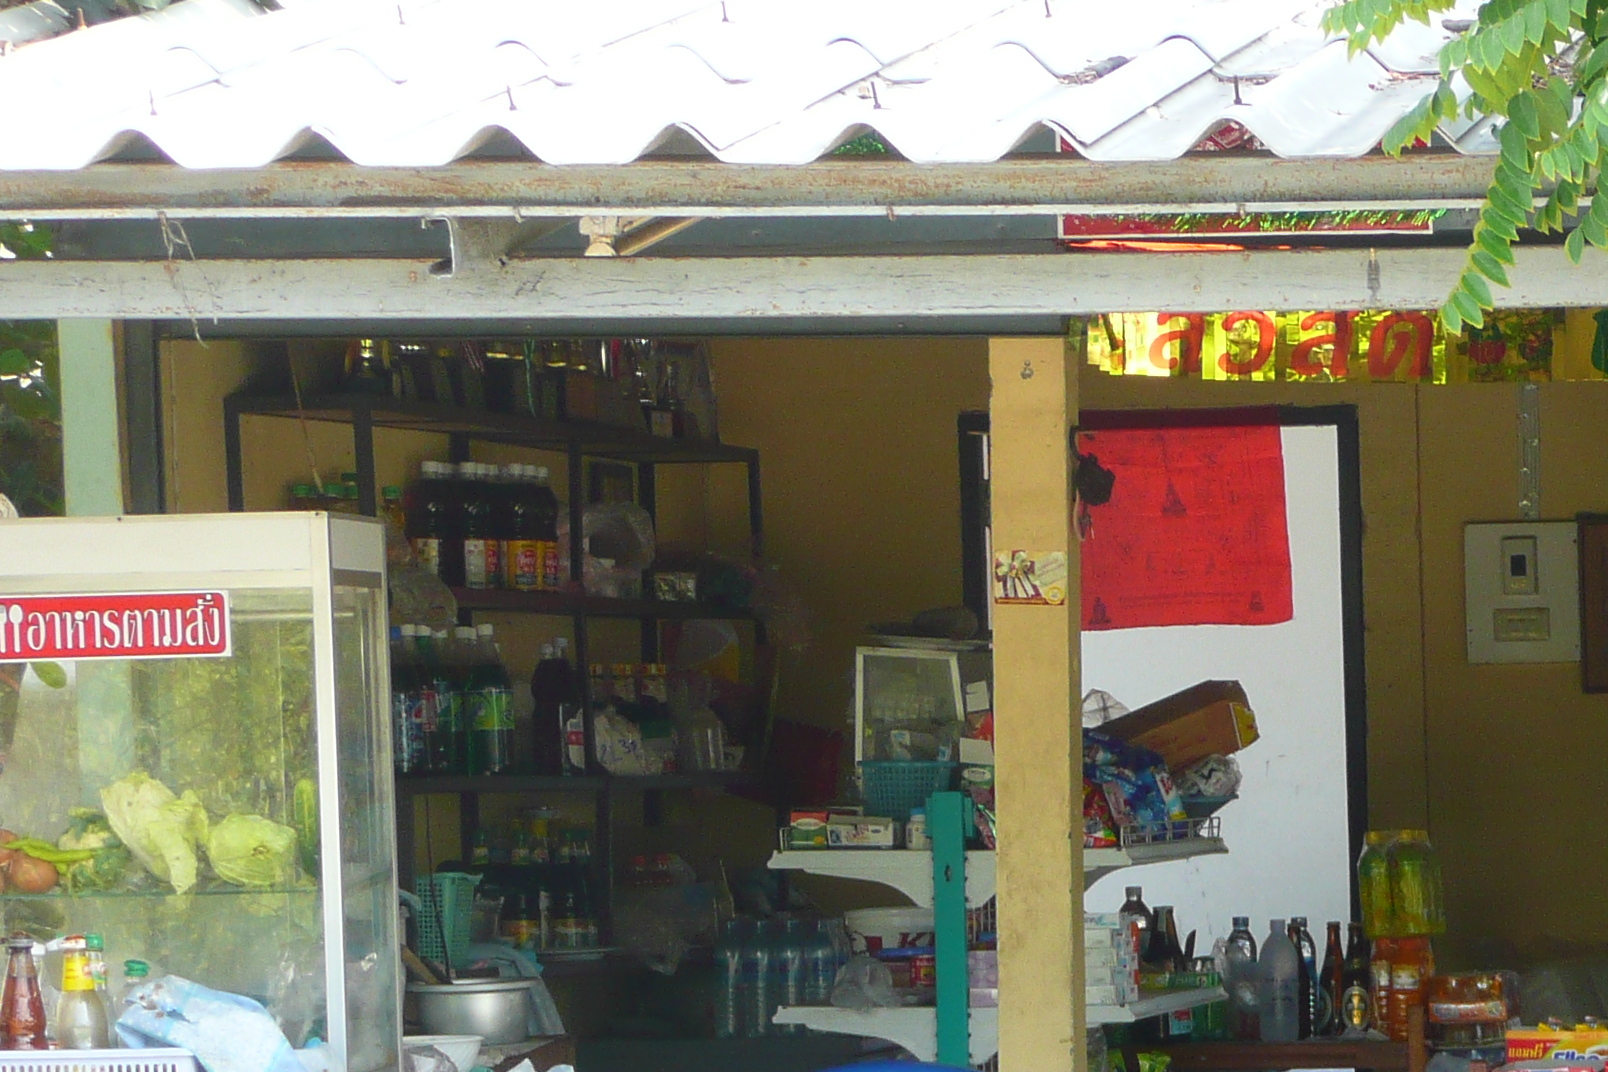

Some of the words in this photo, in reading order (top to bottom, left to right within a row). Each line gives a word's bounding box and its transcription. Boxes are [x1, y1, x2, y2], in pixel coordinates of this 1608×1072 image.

[27, 594, 221, 651] อาหารตามสั่ง
